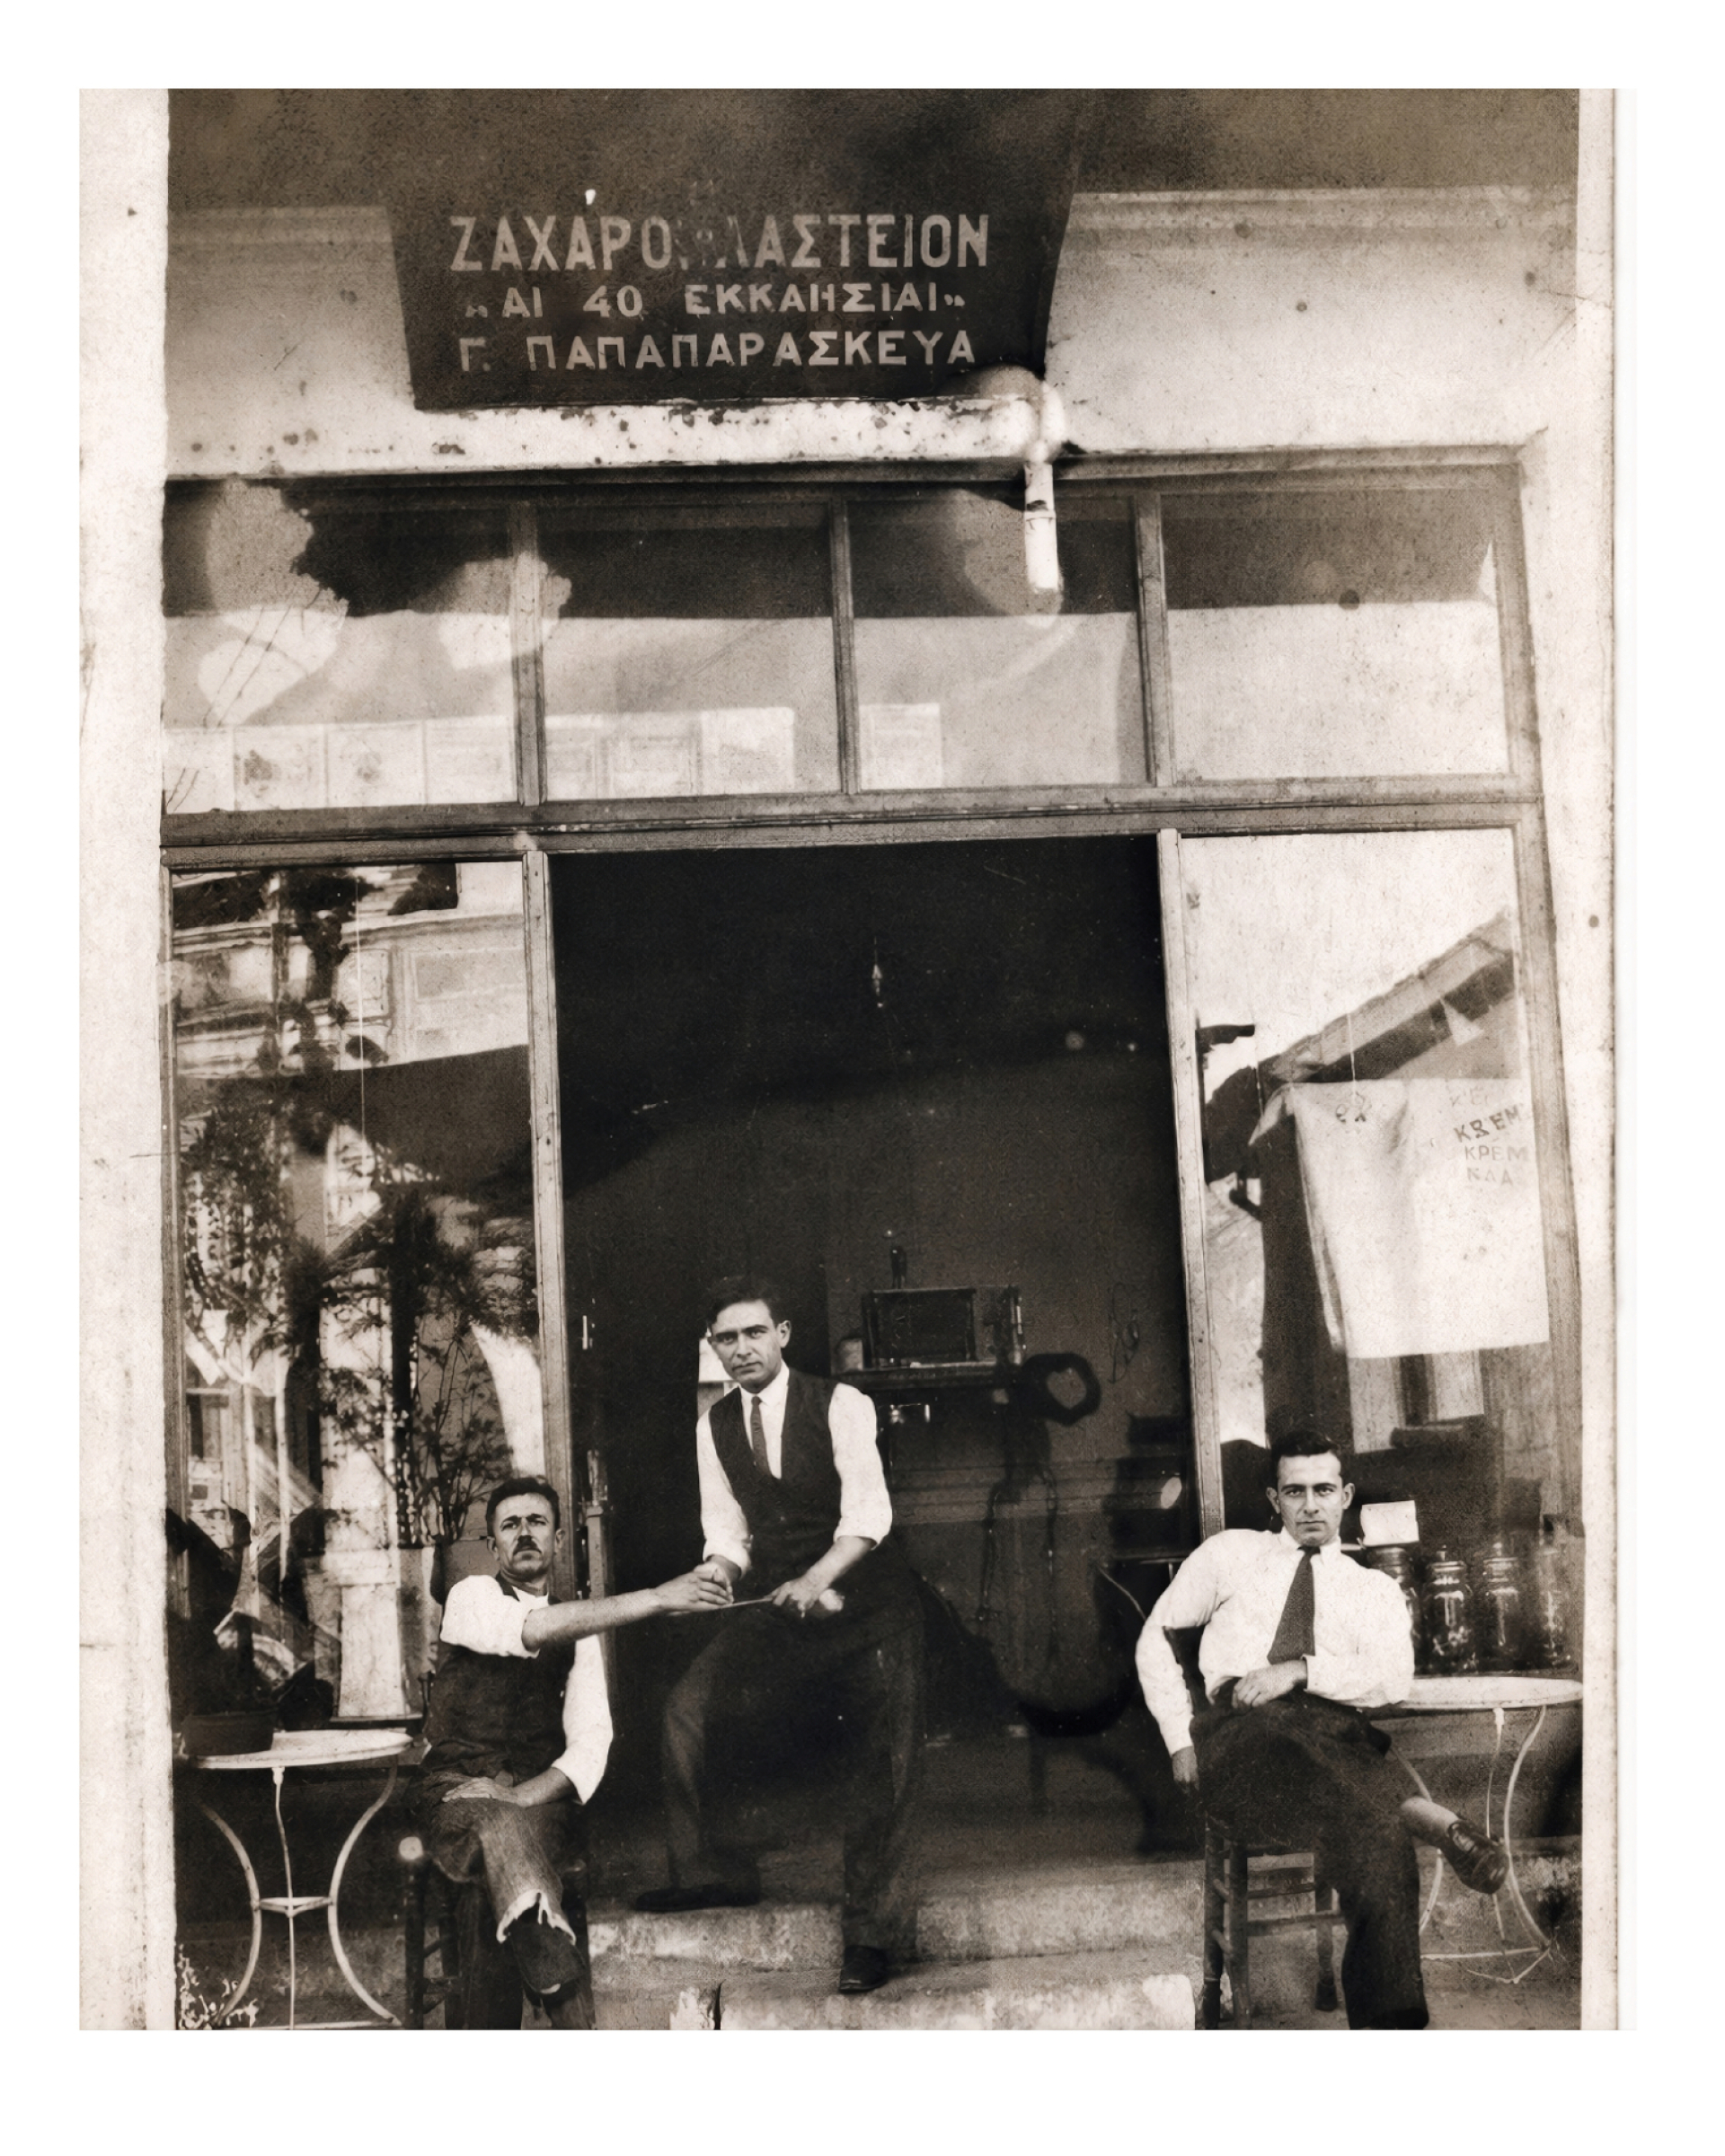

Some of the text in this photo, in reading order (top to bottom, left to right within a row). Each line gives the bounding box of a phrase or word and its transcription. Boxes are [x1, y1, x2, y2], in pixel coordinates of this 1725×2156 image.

[449, 214, 988, 271] ΖΑΧΑΡΟΑΣΤΕΙΟΝ
[582, 283, 644, 319] 40
[525, 330, 976, 370] ΠΑΠΑΠΑΡΑΣΚΕΥΑ
